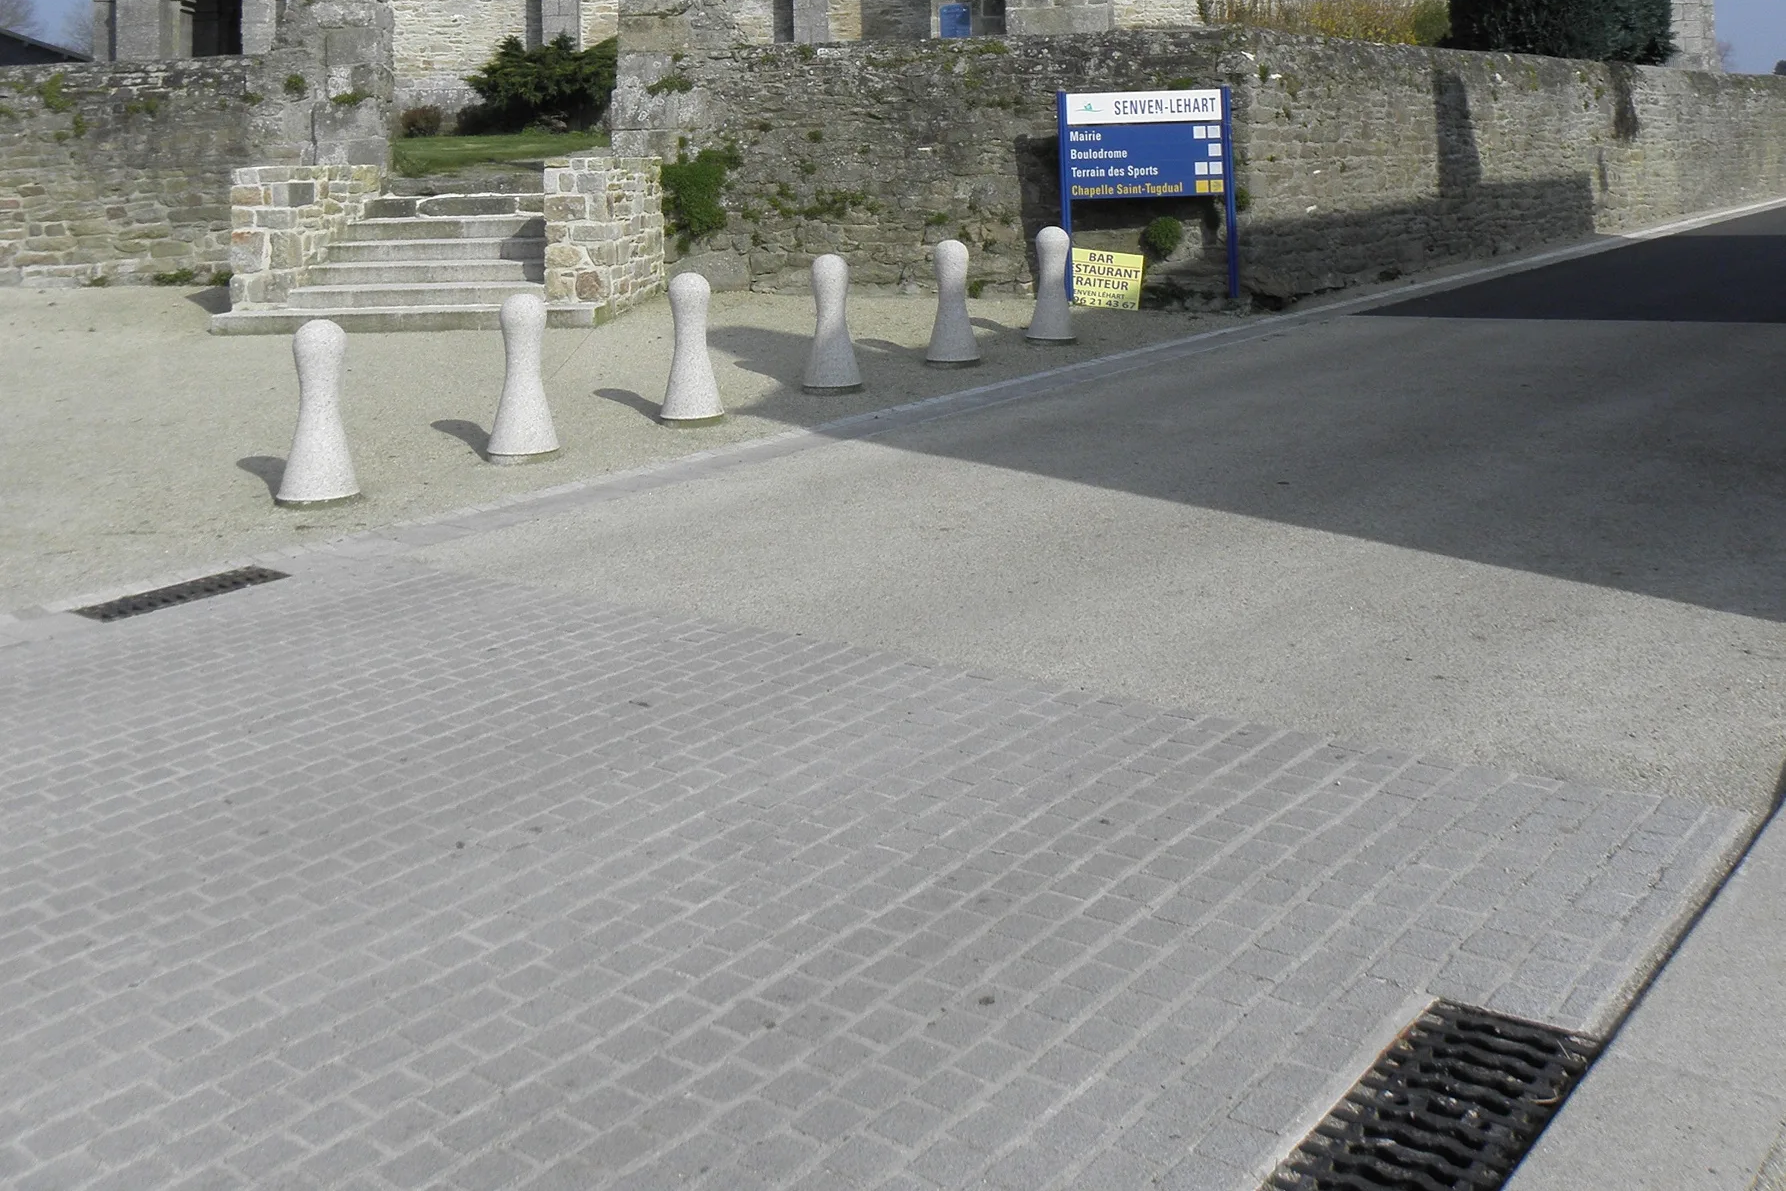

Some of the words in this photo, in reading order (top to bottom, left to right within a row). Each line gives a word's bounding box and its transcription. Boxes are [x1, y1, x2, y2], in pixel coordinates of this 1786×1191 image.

[1114, 97, 1216, 115] SENVEN-LEHART
[1070, 130, 1102, 142] Mairie
[1070, 148, 1128, 160] Boulodrome
[1071, 165, 1105, 178] Terrain
[1108, 164, 1125, 176] des
[1127, 164, 1159, 178] Sports
[1071, 184, 1114, 198] Chapelle
[1116, 182, 1183, 196] Saint-Tugdual
[1089, 252, 1114, 264] BAR
[1073, 263, 1140, 279] STAURANT
[1089, 297, 1102, 306] 21
[1105, 300, 1119, 308] 43
[1122, 301, 1136, 309] 67
